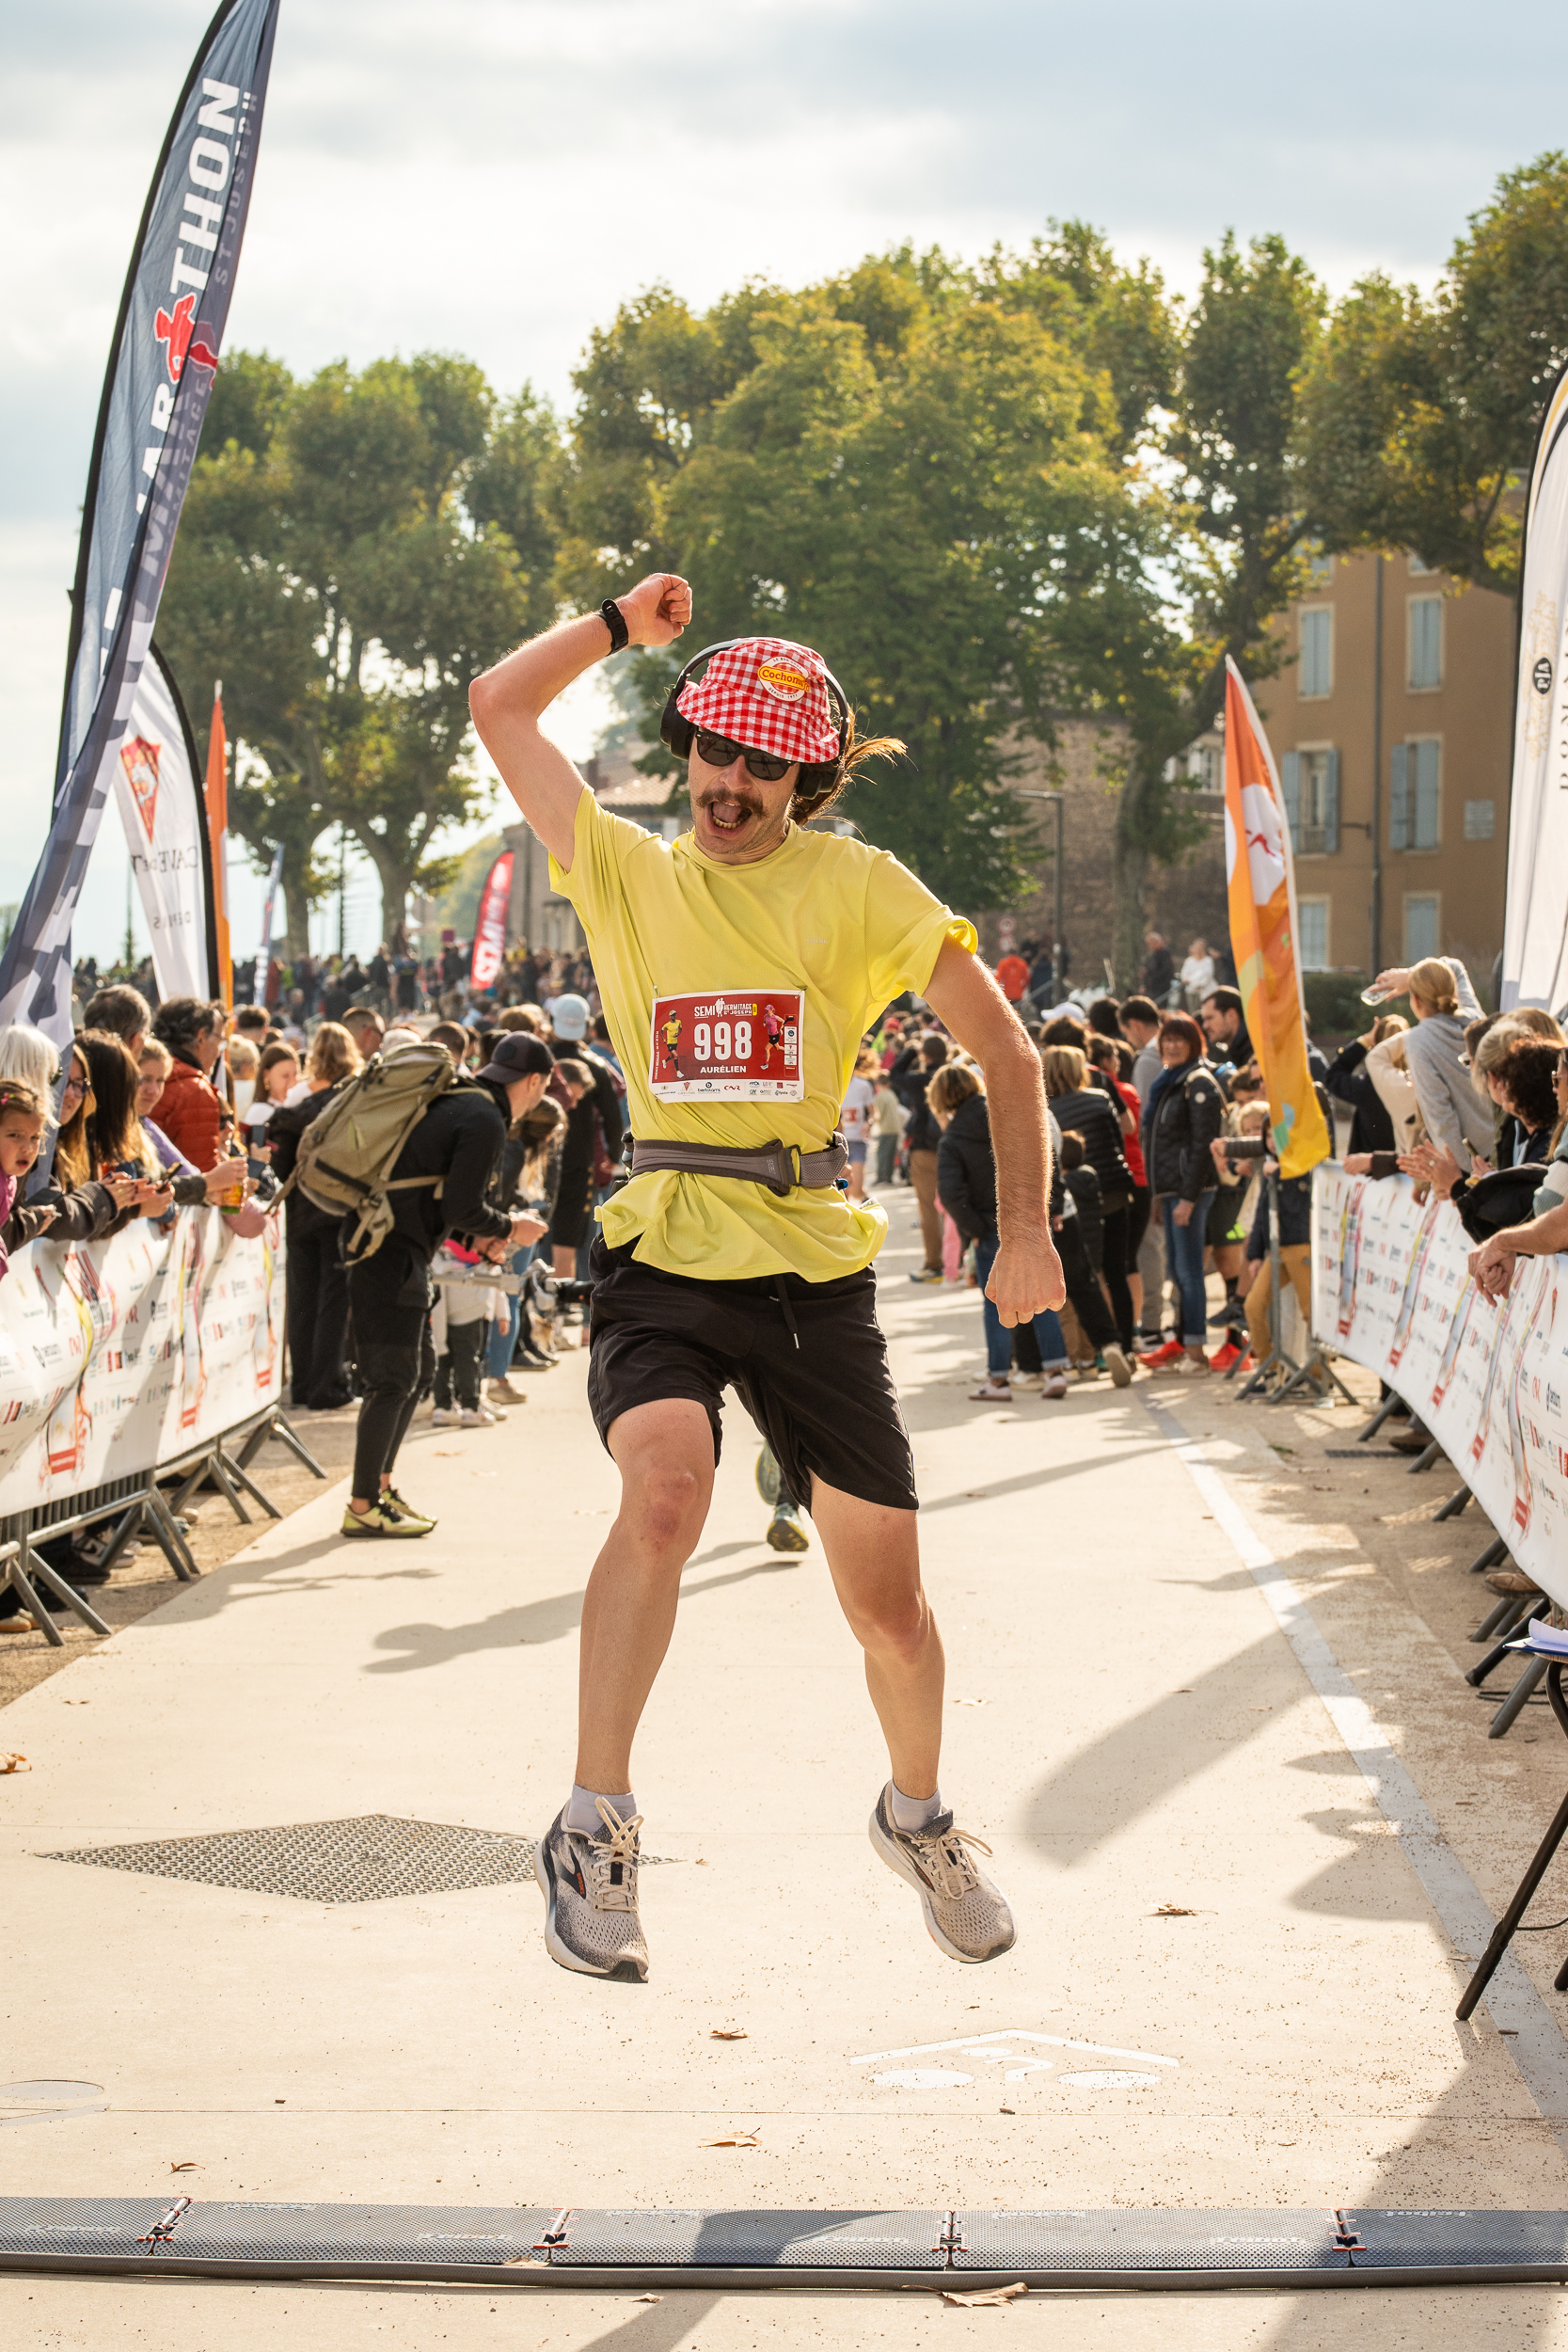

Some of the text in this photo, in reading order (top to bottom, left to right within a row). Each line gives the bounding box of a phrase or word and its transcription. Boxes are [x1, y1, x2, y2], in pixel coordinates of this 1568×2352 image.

[694, 1007, 716, 1017] SEMI
[693, 1021, 752, 1061] 998
[700, 1065, 747, 1073] AURÉLIEN
